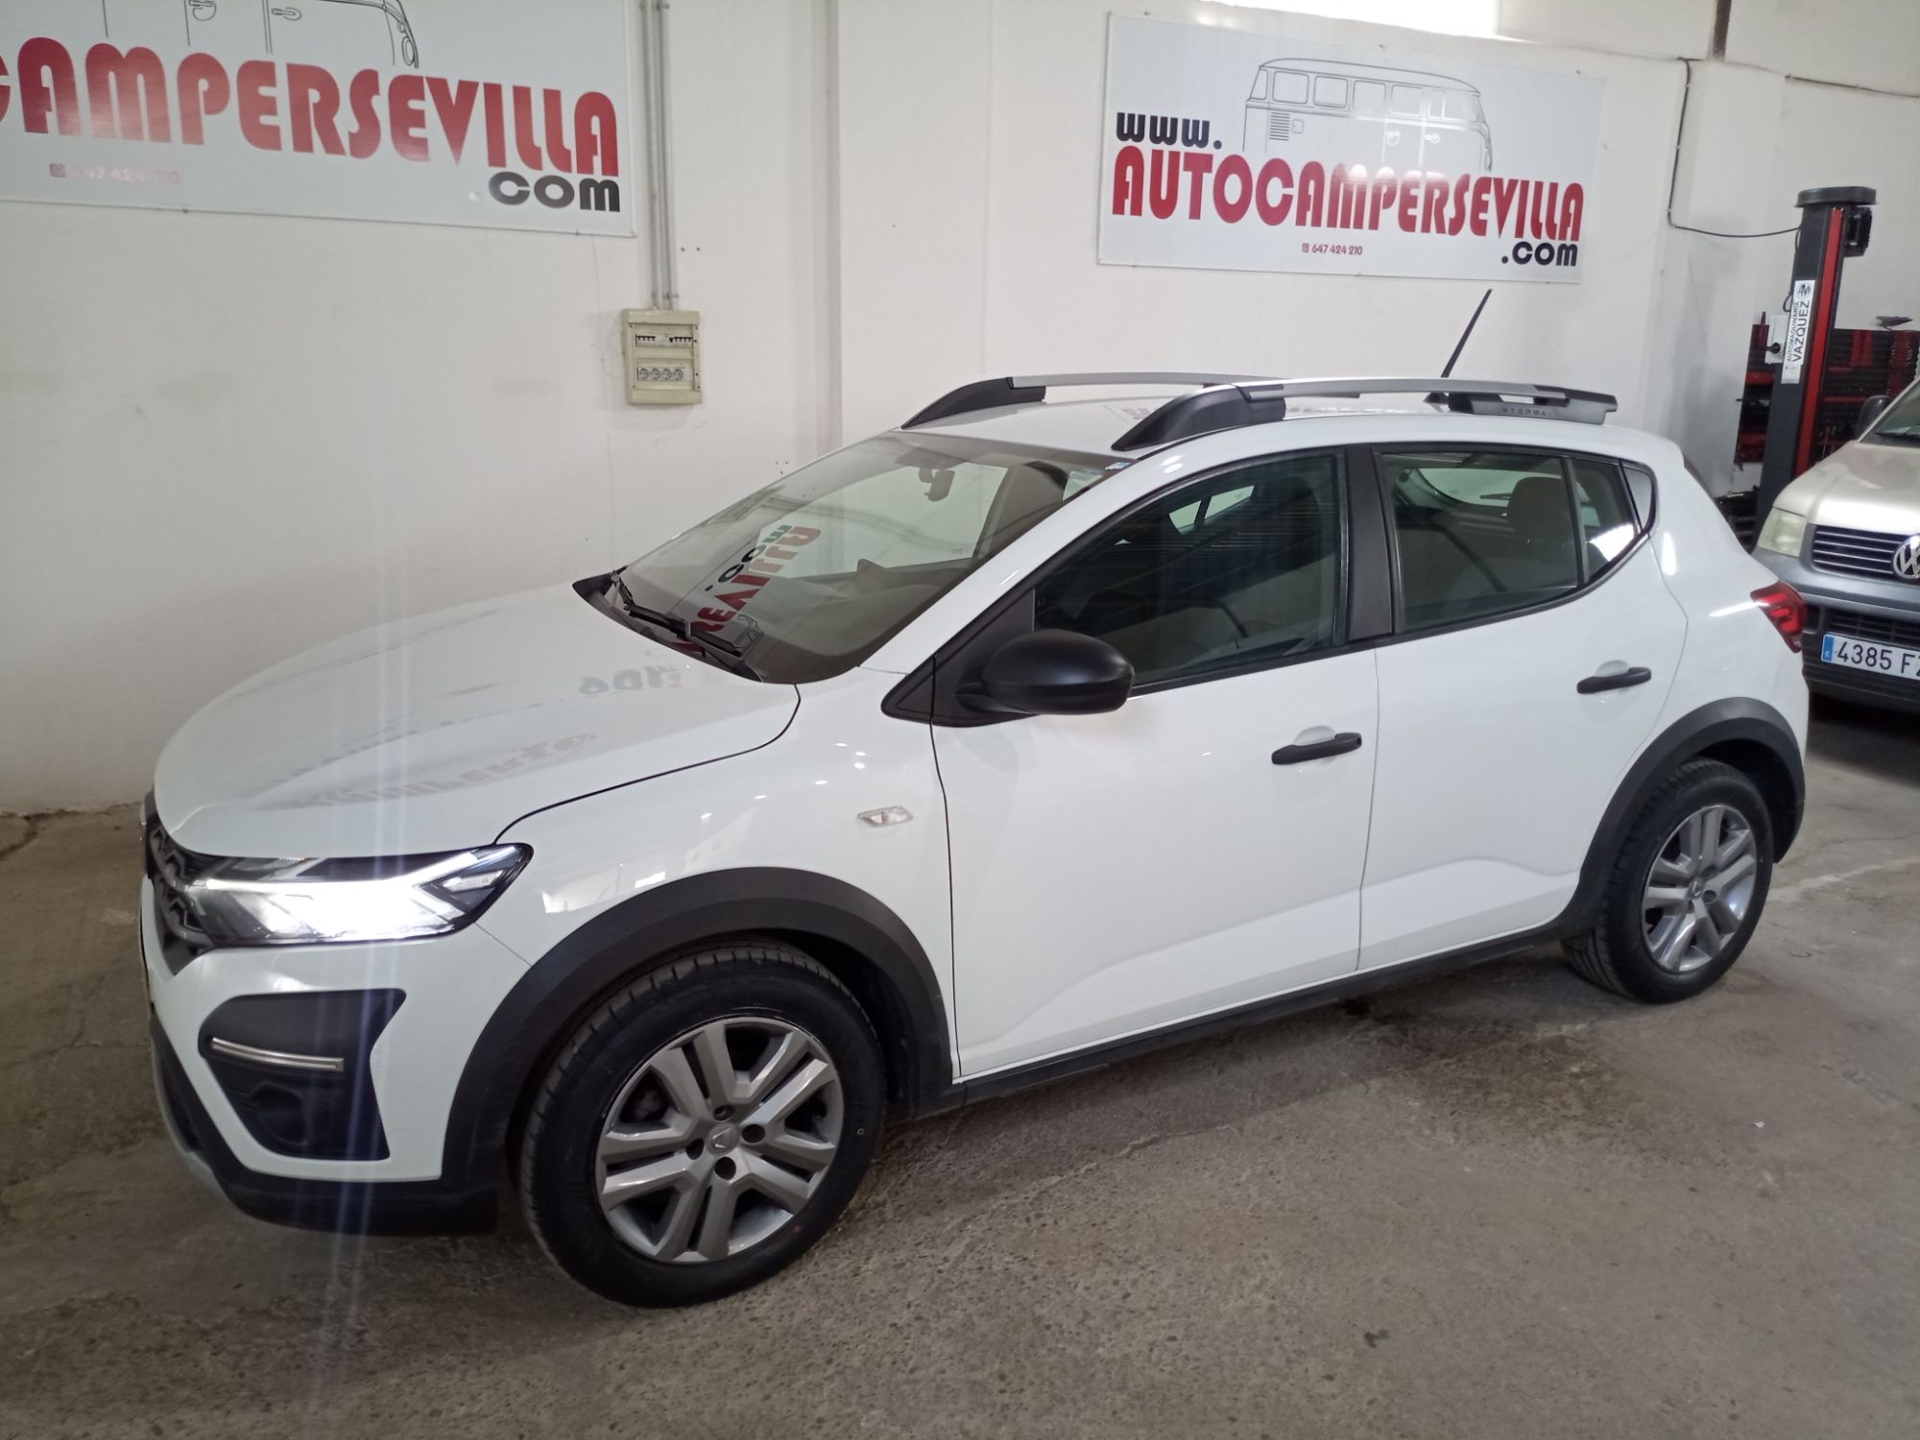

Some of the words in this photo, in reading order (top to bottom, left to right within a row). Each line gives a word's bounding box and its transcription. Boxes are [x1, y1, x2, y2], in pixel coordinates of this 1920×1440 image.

[0, 36, 620, 178] AMPERSEVILLA
[1112, 145, 1585, 242] AUTOCAMPERSEVILLA
[1311, 243, 1328, 254] 647
[1330, 244, 1347, 255] 424
[1348, 245, 1363, 256] 210
[1792, 300, 1811, 363] VAZQUEZ
[1837, 641, 1892, 670] 4385
[1900, 653, 1920, 676] F
